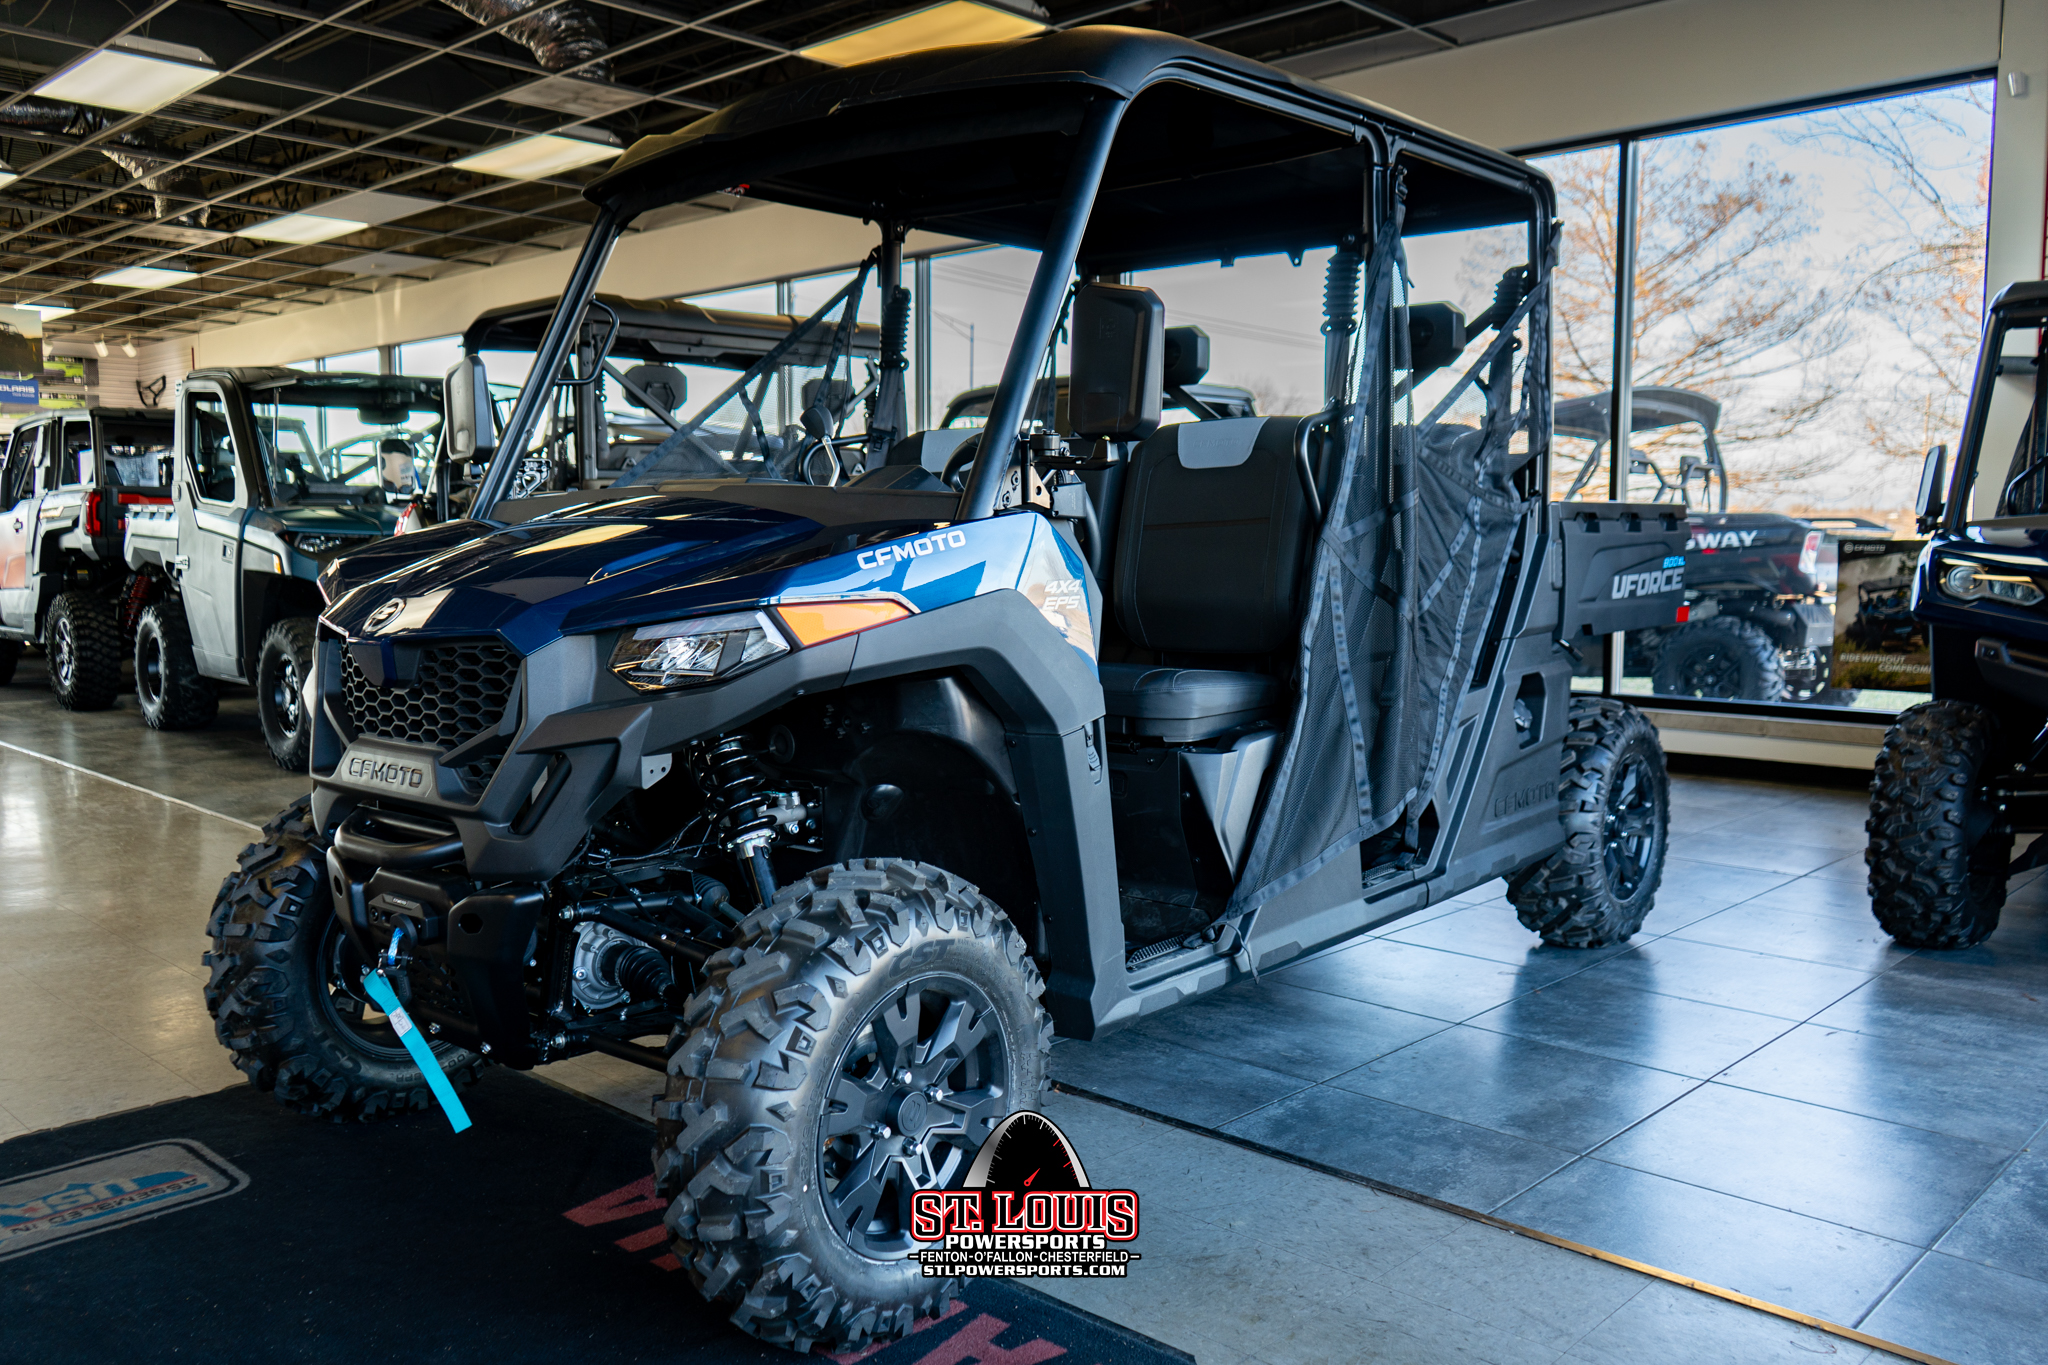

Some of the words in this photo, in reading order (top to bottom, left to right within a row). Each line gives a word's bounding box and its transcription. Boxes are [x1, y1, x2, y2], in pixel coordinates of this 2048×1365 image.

[856, 530, 966, 570] CFMOTO
[1044, 579, 1082, 595] 4X4
[1611, 567, 1685, 600] UFORCE
[1042, 595, 1081, 611] EPS
[1840, 652, 1861, 663] RIDE
[1861, 653, 1906, 665] WITHOUT
[349, 757, 423, 788] CFMOTO
[1494, 781, 1556, 818] CFMOTO
[889, 939, 956, 978] CST
[48, 1177, 198, 1225] ASSEMBLED
[10, 1222, 37, 1235] IN
